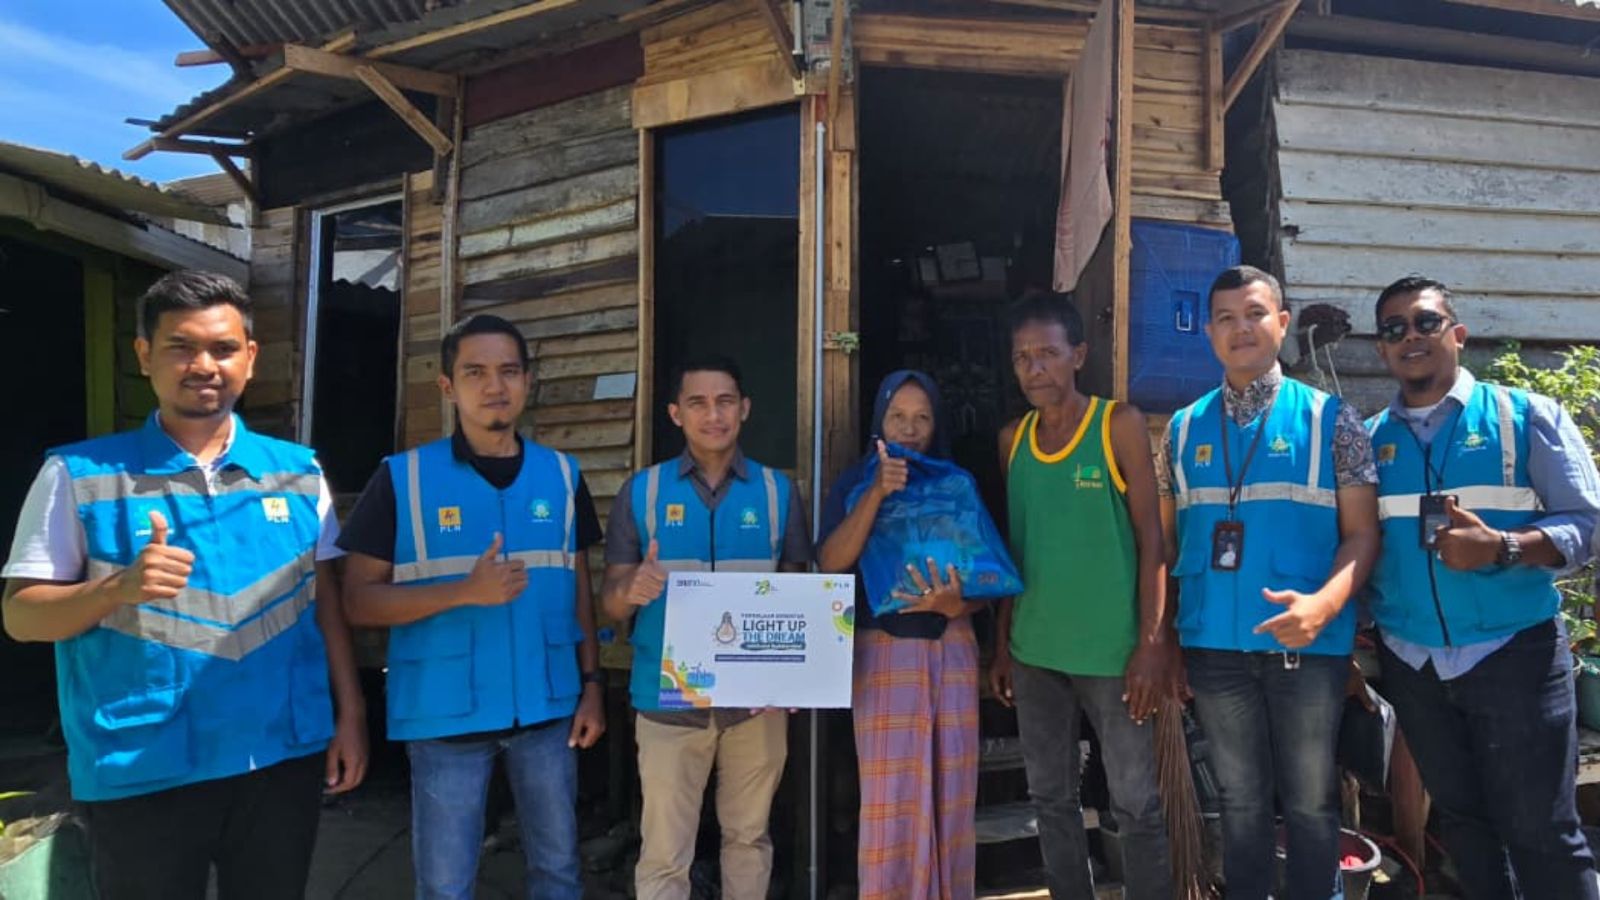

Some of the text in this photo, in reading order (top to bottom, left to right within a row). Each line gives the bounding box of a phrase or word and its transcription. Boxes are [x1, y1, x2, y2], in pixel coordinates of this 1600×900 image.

[664, 519, 684, 527] PLN
[439, 525, 461, 534] PLN
[743, 620, 807, 631] LIGHT UP
[743, 631, 806, 643] THE DREAM
